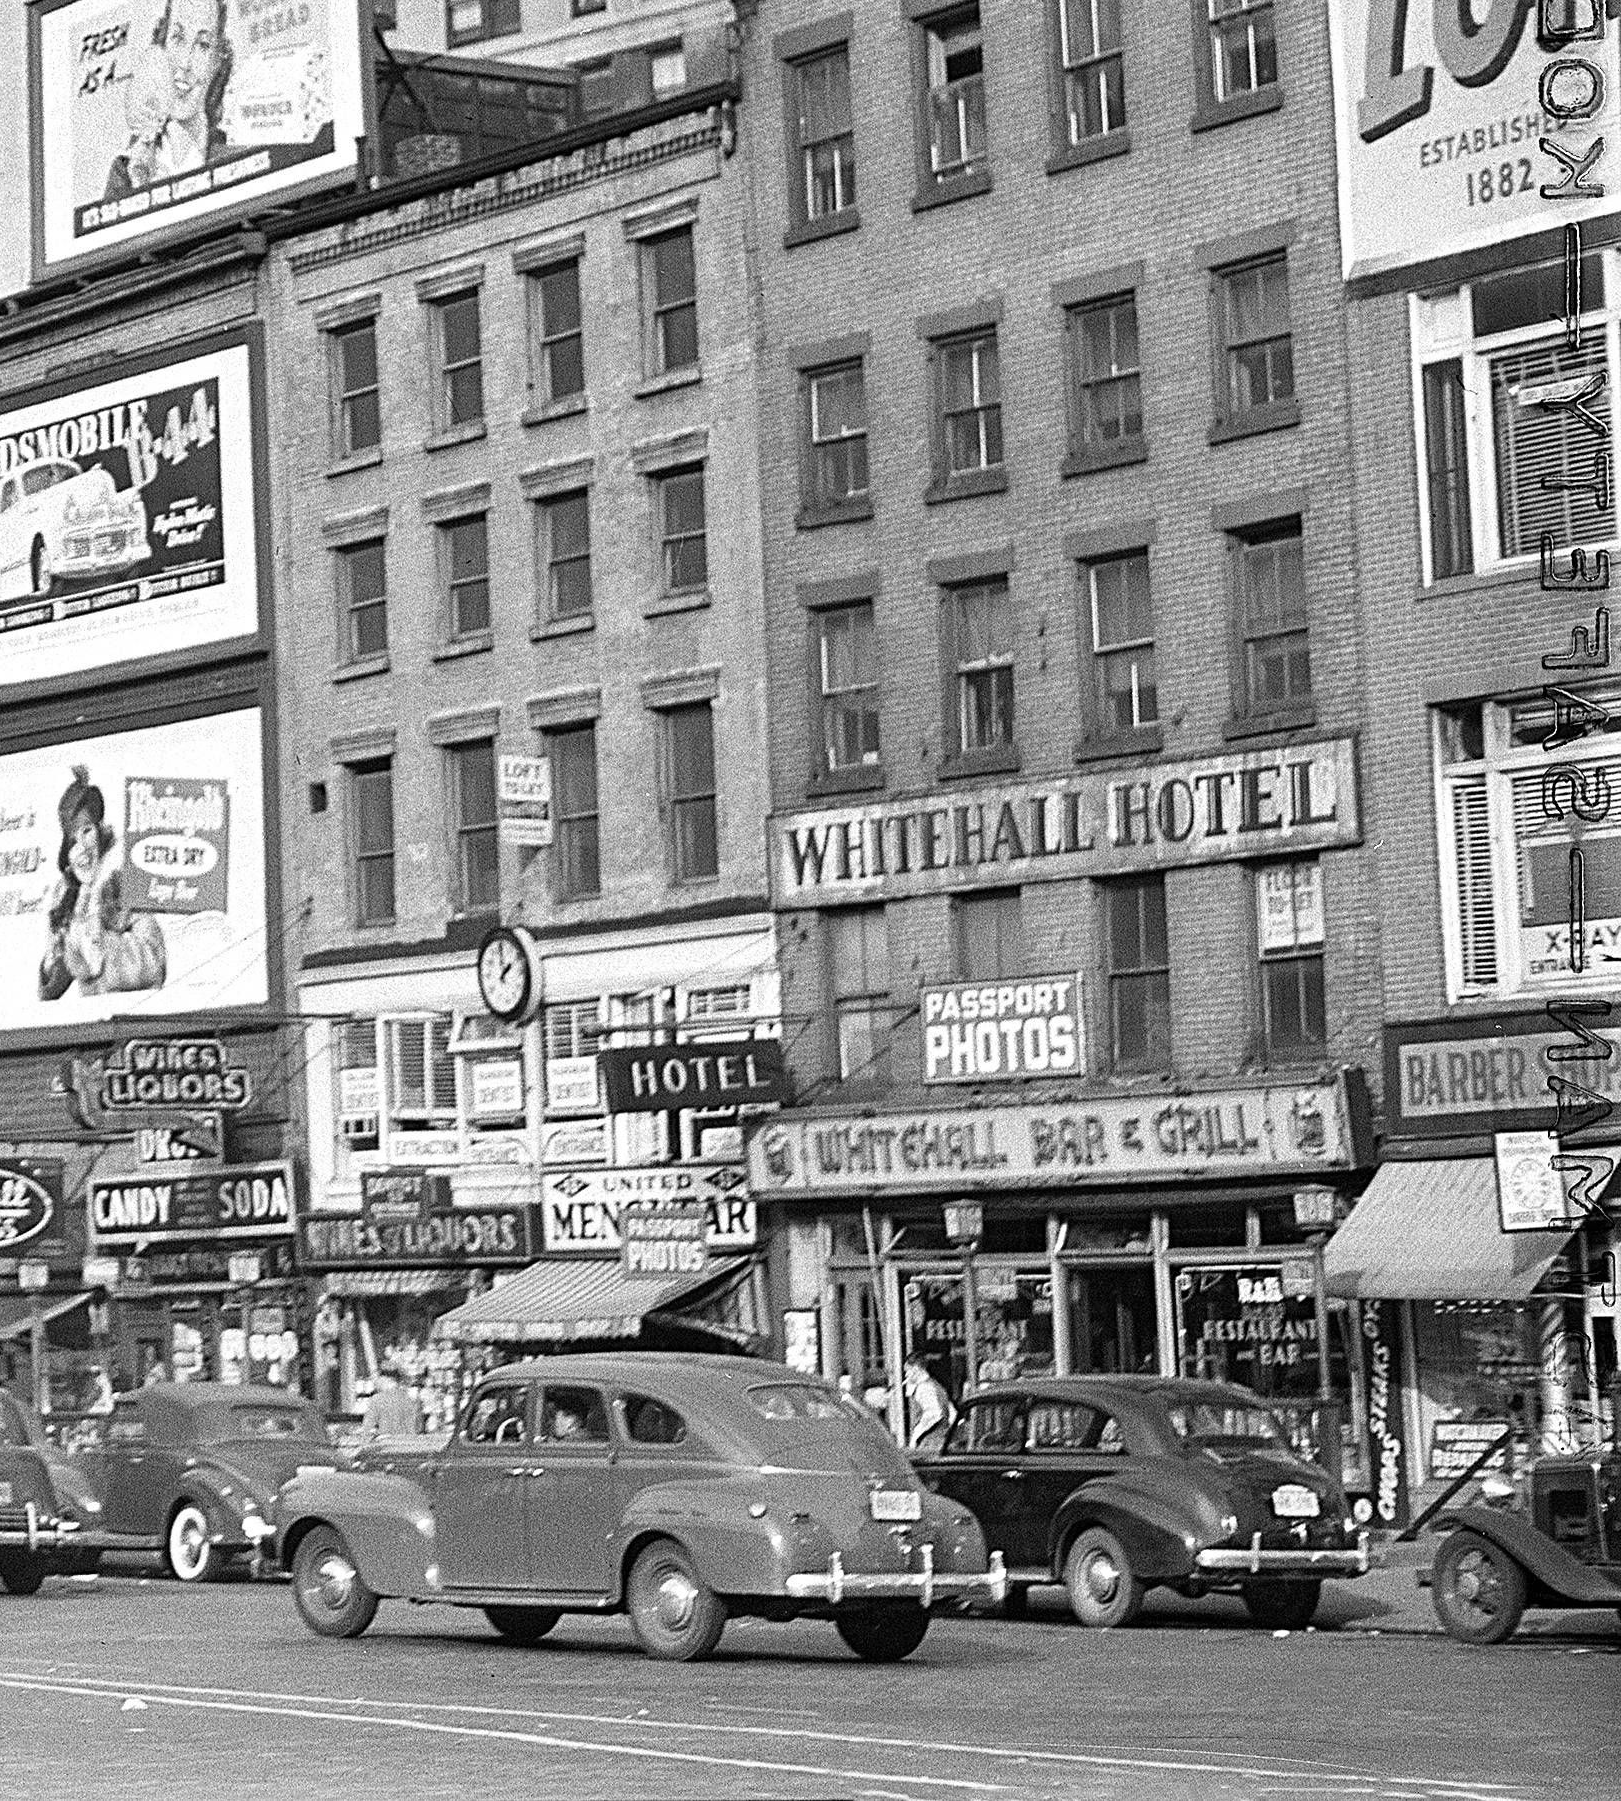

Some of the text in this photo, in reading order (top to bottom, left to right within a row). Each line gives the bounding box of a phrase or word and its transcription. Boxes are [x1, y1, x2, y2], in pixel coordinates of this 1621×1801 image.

[1466, 157, 1536, 207] 1882
[786, 759, 1339, 889] WHITEHALL HOTEL
[925, 981, 1073, 1023] PASSPORT
[132, 1044, 220, 1070] WINES
[925, 1017, 1077, 1081] PHOTOS
[109, 1072, 245, 1104] LIQUORS
[632, 1055, 771, 1097] HOTEL
[1407, 1047, 1527, 1108] BARBER
[812, 1115, 1011, 1177] WHITEHALL
[1029, 1114, 1110, 1167] BAR
[1155, 1102, 1259, 1159] GRILL
[93, 1176, 289, 1229] CANDY SODA
[603, 1173, 692, 1192] UNITED
[1369, 1340, 1391, 1437] STEAKS
